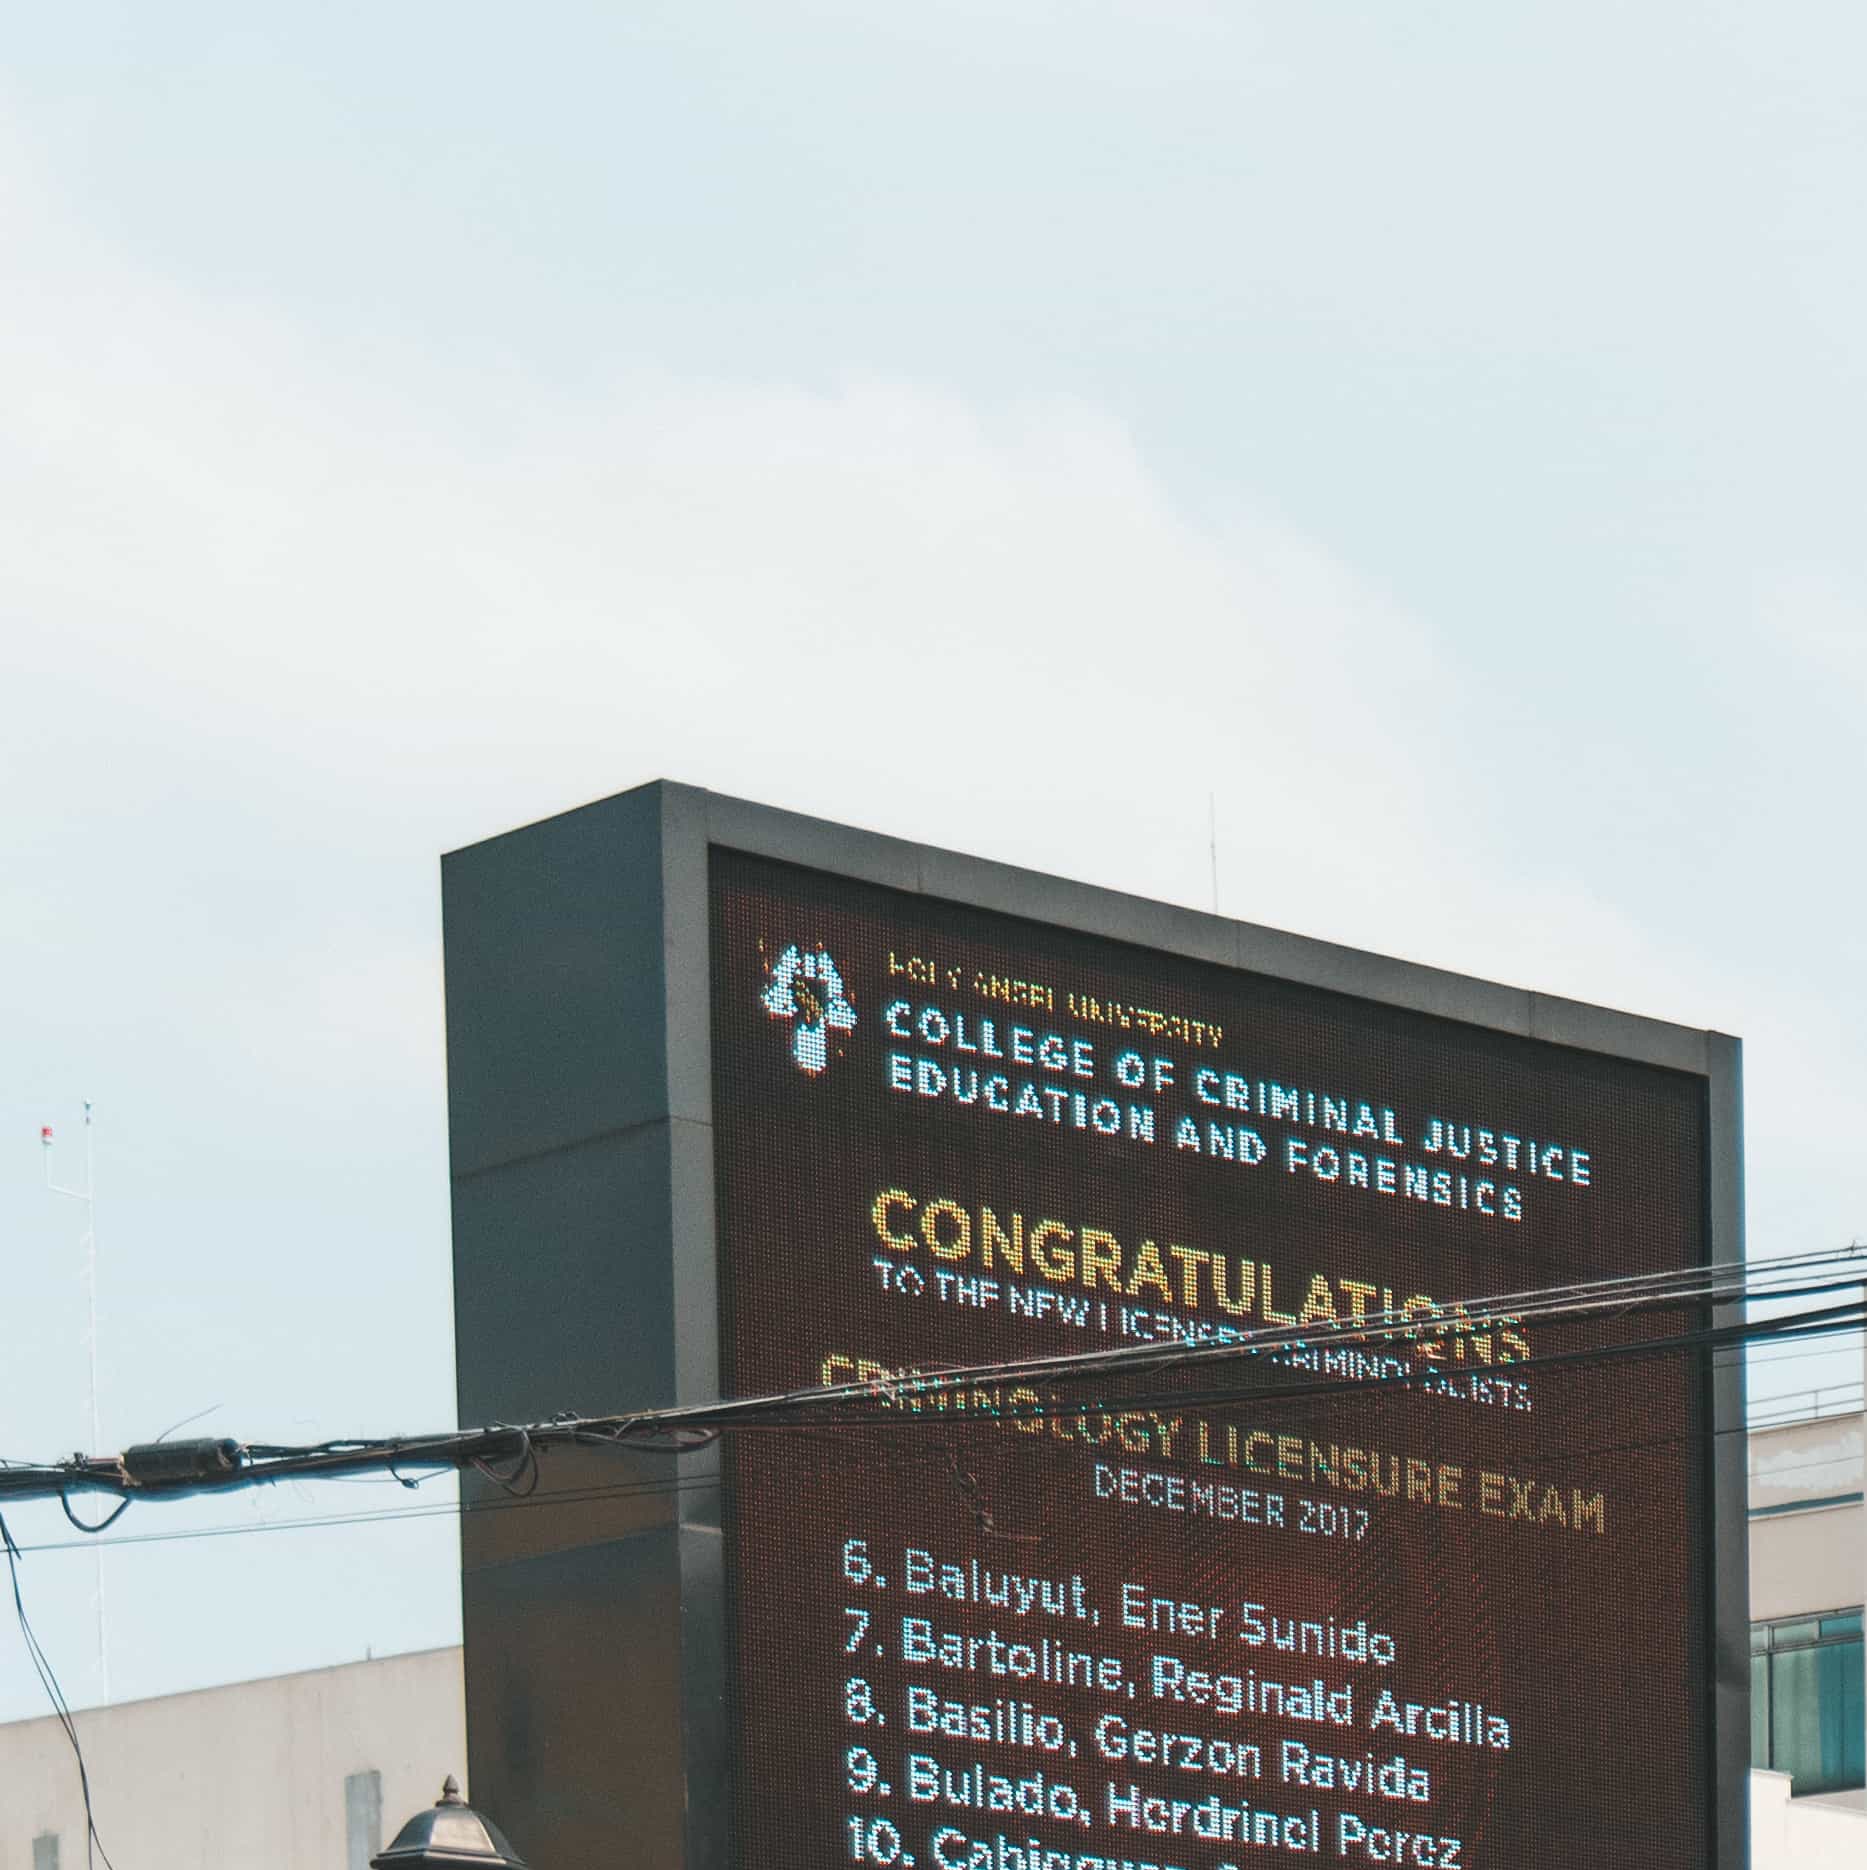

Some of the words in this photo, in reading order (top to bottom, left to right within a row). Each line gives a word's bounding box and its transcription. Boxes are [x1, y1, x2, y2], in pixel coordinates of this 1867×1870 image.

[885, 1000, 1095, 1079] COLLEGE
[1116, 1052, 1175, 1093] OF
[1196, 1066, 1405, 1146] CRIMINAL
[1424, 1118, 1591, 1187] JUSTICE
[890, 1053, 1155, 1144] EDUCATION
[1176, 1114, 1268, 1167] AND
[1286, 1137, 1523, 1222] FORENSICS
[873, 1256, 926, 1297] TO
[1095, 1463, 1285, 1528] DECEMBER
[1299, 1498, 1370, 1541] 2017
[1199, 1420, 1463, 1508] LICENSURE
[1480, 1470, 1605, 1534] EXAM
[842, 1538, 887, 1588] 6.
[905, 1548, 1100, 1627] Baluyut,
[1122, 1582, 1224, 1639] Ener
[1239, 1601, 1396, 1666] Sunido
[844, 1607, 883, 1656] 7.
[902, 1616, 1135, 1699] Bartoline,
[1151, 1655, 1353, 1726] Reginald
[1369, 1689, 1512, 1750] Arcilla
[846, 1746, 892, 1796] 9.
[909, 1753, 1092, 1829] Bulado,
[907, 1685, 1078, 1758] Basilio,
[1095, 1713, 1262, 1779] Gerzon
[1281, 1739, 1431, 1802] Ravida
[848, 1814, 917, 1868] 10.
